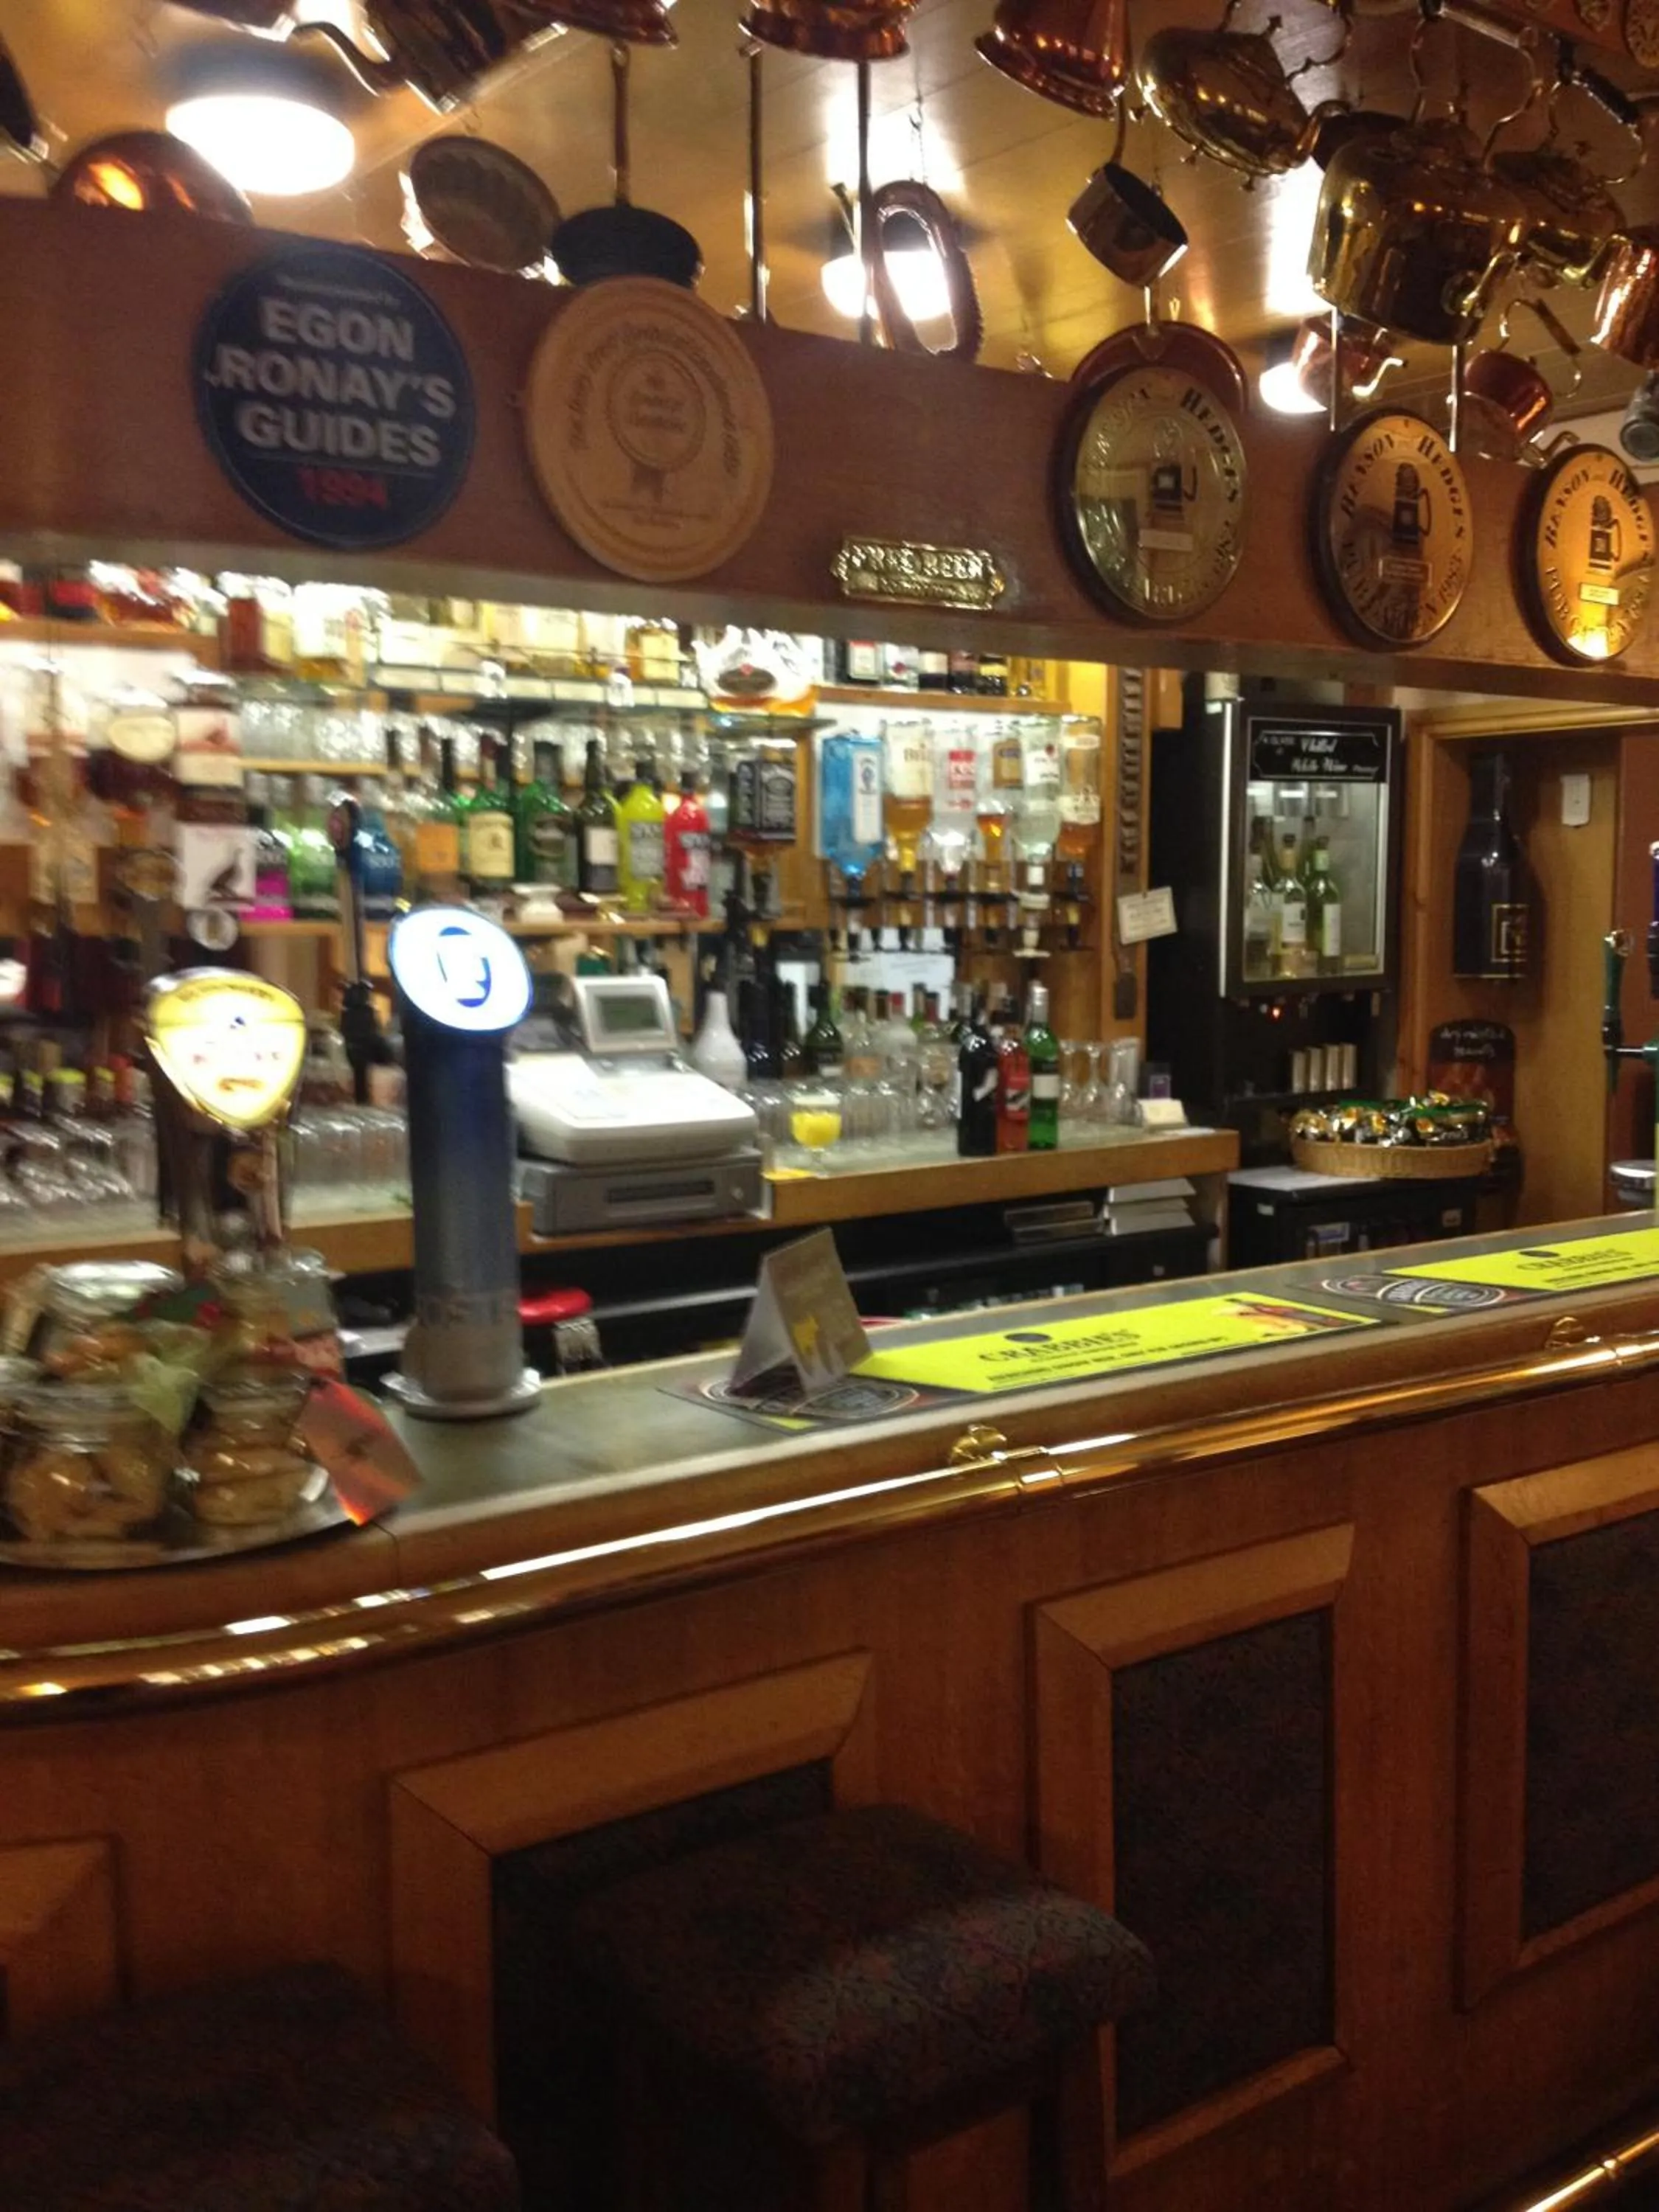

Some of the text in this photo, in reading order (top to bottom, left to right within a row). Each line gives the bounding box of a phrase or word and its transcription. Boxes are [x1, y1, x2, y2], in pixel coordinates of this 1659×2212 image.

[262, 296, 414, 361] EGON
[216, 344, 455, 418] RONAY'S
[237, 402, 441, 467] GUIDES
